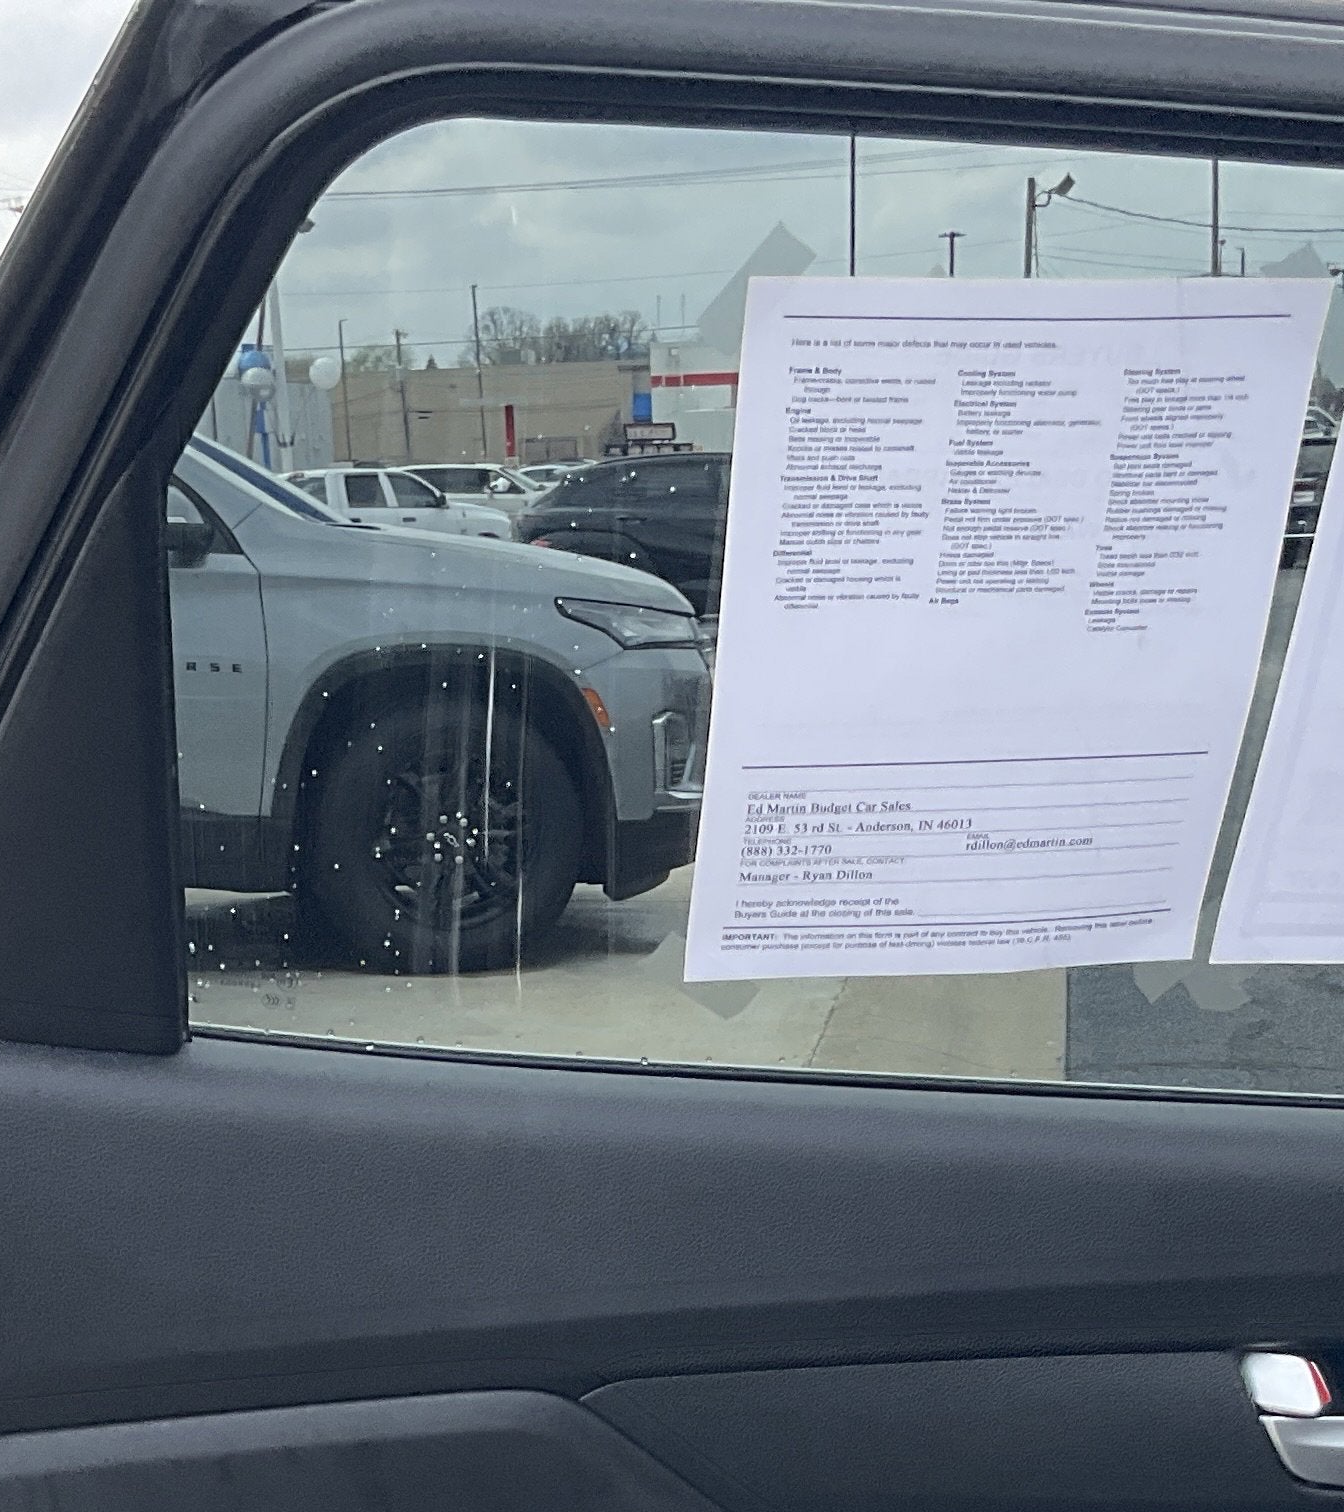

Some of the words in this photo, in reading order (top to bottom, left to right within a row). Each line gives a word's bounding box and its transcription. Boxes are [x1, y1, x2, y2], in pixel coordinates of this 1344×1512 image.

[747, 804, 763, 815] Ed
[767, 804, 806, 814] Martin
[811, 802, 851, 814] Budget
[857, 802, 876, 812] Car
[881, 801, 911, 811] Sales
[745, 824, 773, 834] 2109
[794, 823, 807, 833] 53
[812, 823, 824, 832] rd
[855, 822, 913, 832] Anderson,
[918, 820, 934, 830] IN
[937, 818, 972, 829] 46013
[741, 847, 772, 857] (888)
[777, 845, 832, 856] 332-1770
[739, 872, 790, 882] Manager
[803, 871, 832, 882] Ryan
[836, 870, 873, 879] Dillon
[742, 900, 773, 908] hereby
[734, 911, 766, 920] Buyers
[770, 910, 797, 918] Guide
[811, 909, 826, 917] the
